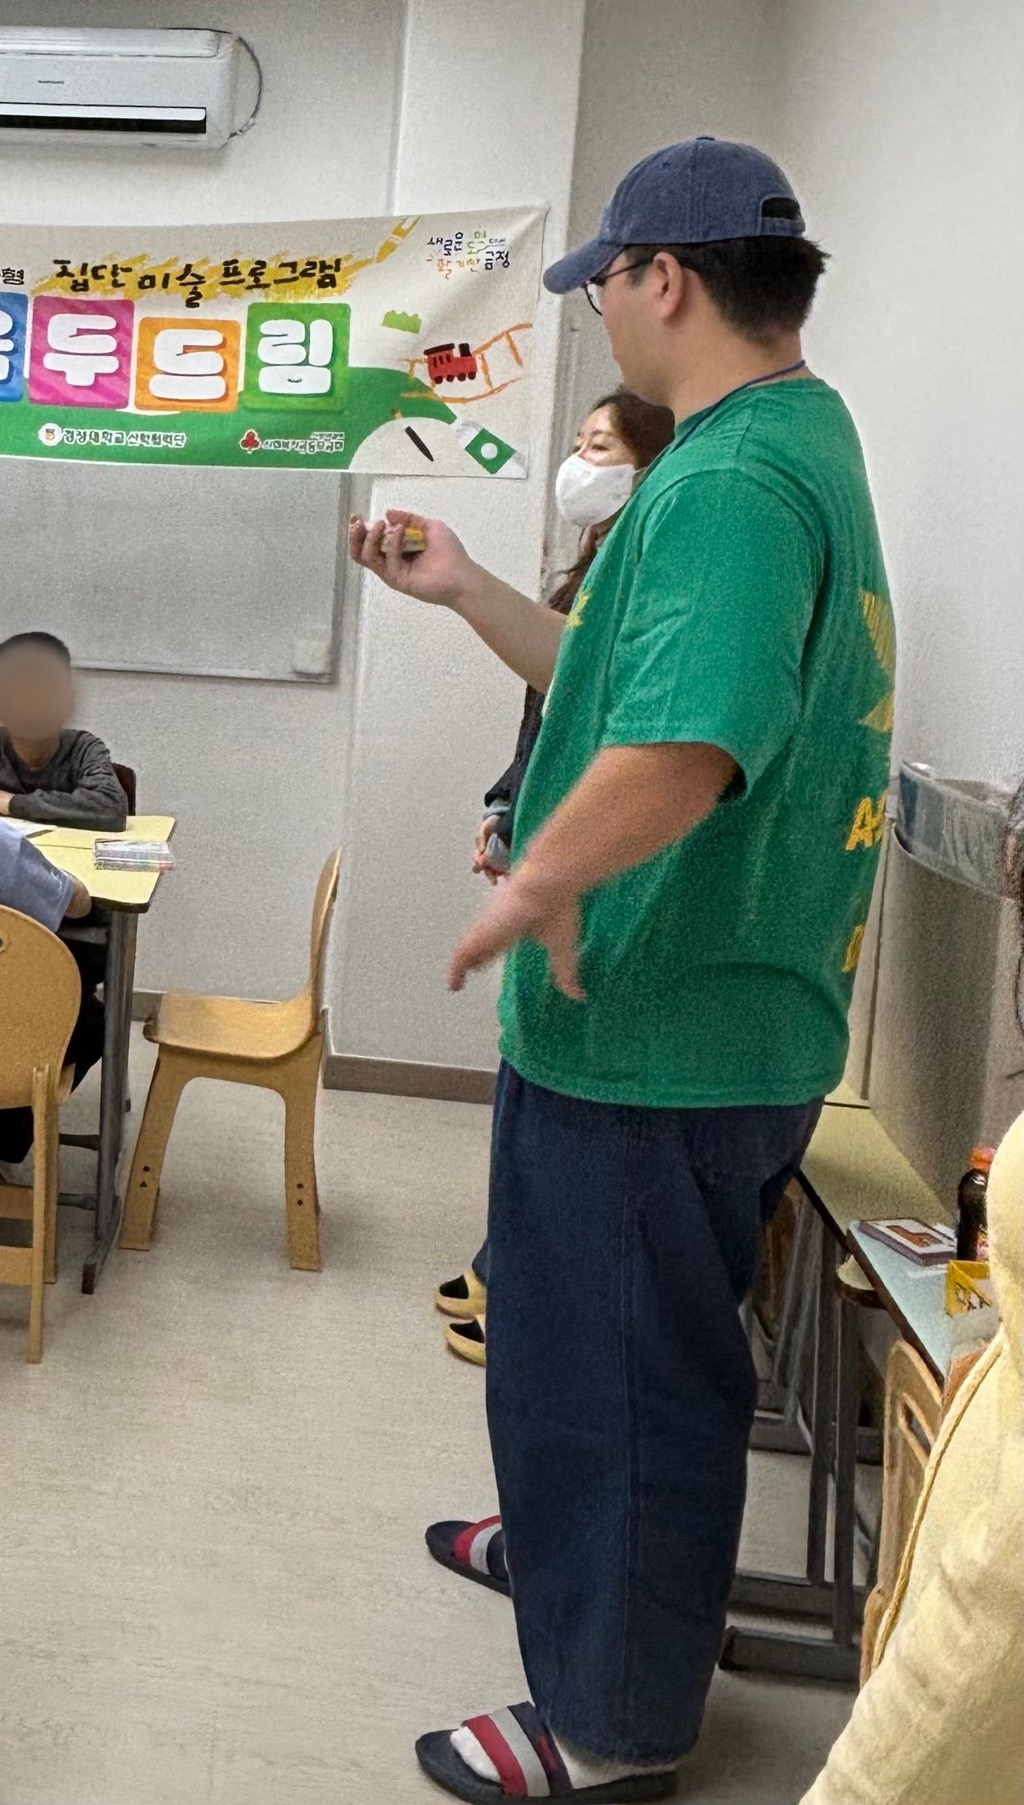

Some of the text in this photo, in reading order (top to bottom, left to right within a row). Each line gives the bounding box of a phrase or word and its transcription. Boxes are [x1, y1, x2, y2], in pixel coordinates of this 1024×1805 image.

[484, 250, 511, 271] 금정
[53, 257, 342, 308] 집단 미술 프로그램
